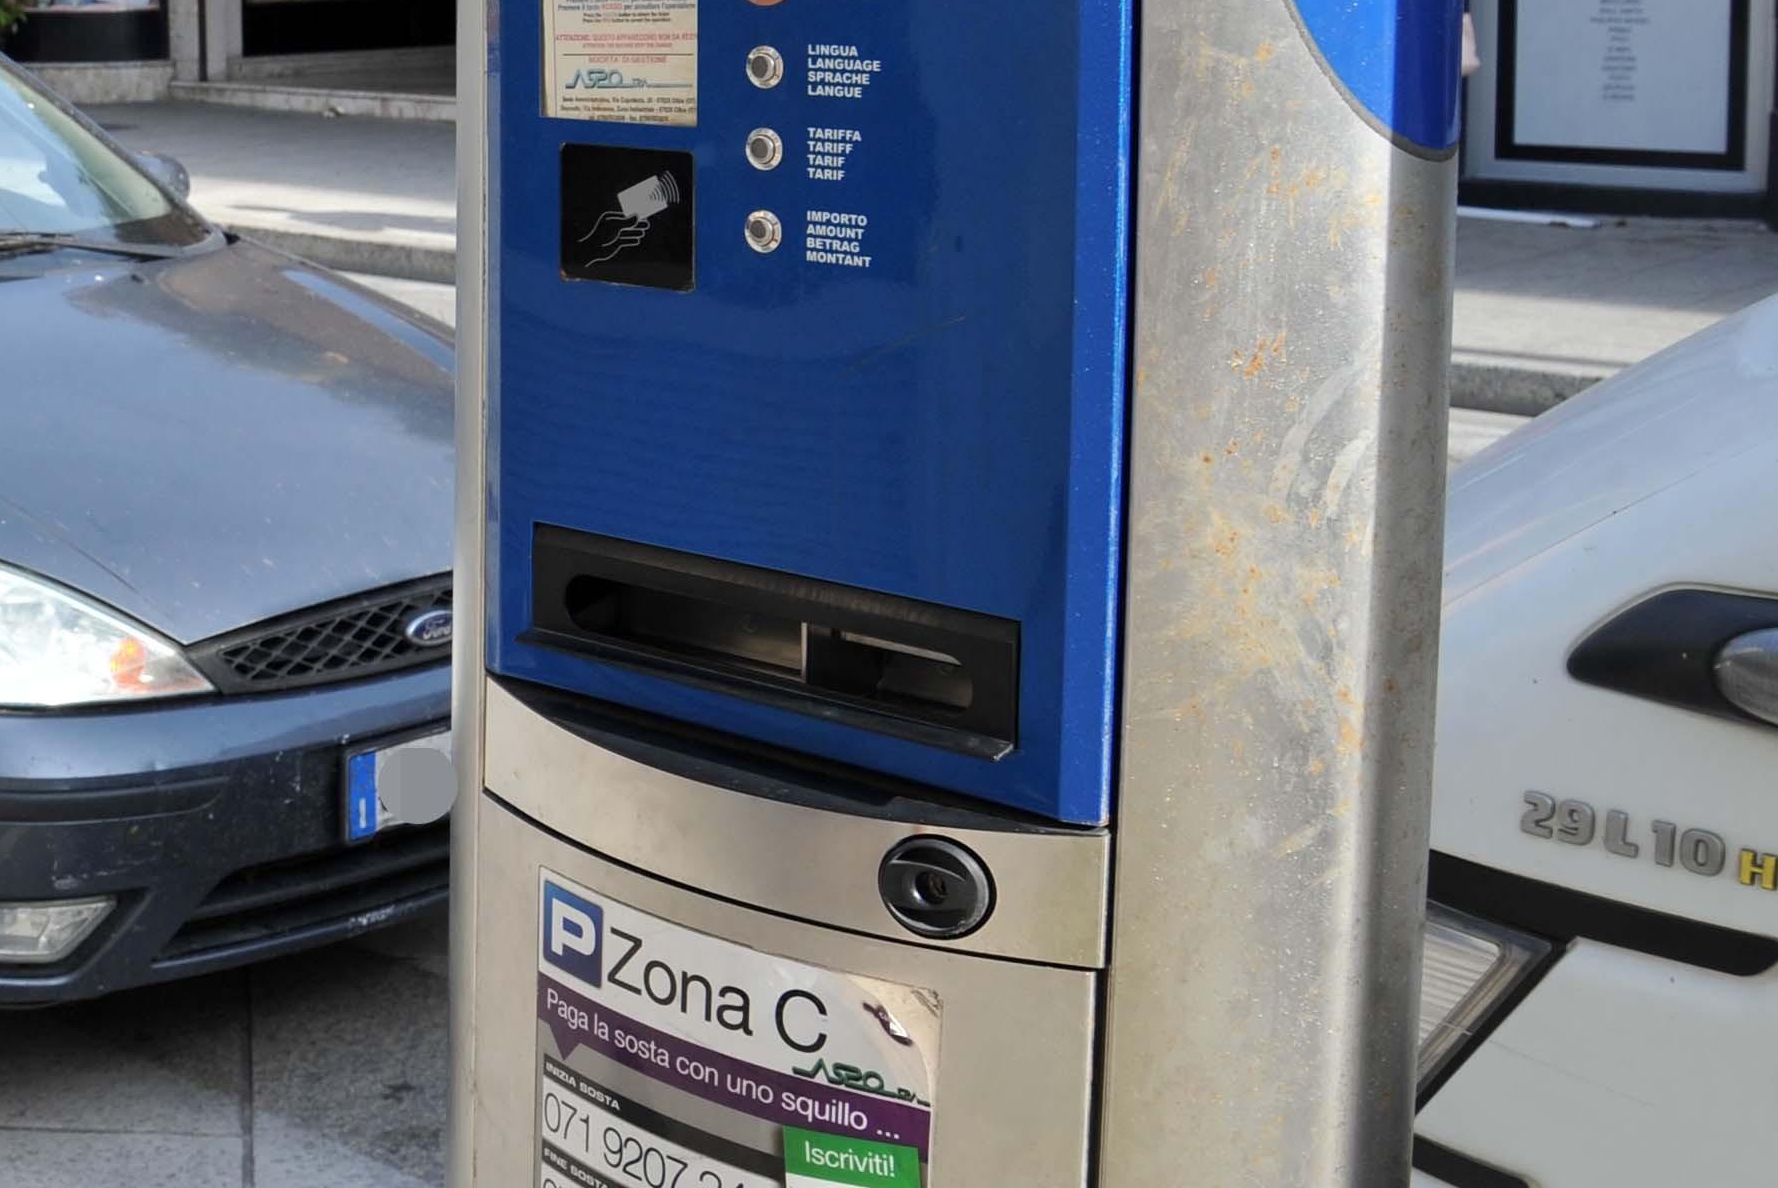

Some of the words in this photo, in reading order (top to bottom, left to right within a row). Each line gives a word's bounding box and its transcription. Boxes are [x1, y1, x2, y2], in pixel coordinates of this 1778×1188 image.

[807, 43, 859, 57] LINGUA
[807, 57, 882, 72] LANGUAGE
[807, 70, 871, 85] SPRACHE
[807, 84, 863, 98] LANGUE
[807, 127, 862, 142] TARIFFA
[807, 140, 854, 154] TARIFF
[807, 154, 846, 168] TARIF
[807, 167, 846, 181] TARIF
[807, 210, 868, 226] IMPORTO
[806, 224, 865, 240] AMOUNT
[806, 237, 860, 253] BETRAG
[806, 250, 872, 268] MONTANT
[551, 897, 596, 956] P
[607, 927, 754, 1037] Zona
[775, 989, 828, 1053] C
[547, 987, 589, 1031] Paga
[593, 1010, 609, 1042] la
[614, 1024, 670, 1069] sosta
[676, 1055, 719, 1087] con
[726, 1073, 773, 1104] uno
[781, 1091, 868, 1131] squillo
[546, 1062, 577, 1088] INIZIA
[579, 1082, 622, 1111] SOSTA
[544, 1092, 591, 1153] 071
[603, 1127, 689, 1188] 9207
[804, 1140, 896, 1178] Iscriviti!
[544, 1147, 578, 1170] FINE
[580, 1164, 618, 1188] SOSTA
